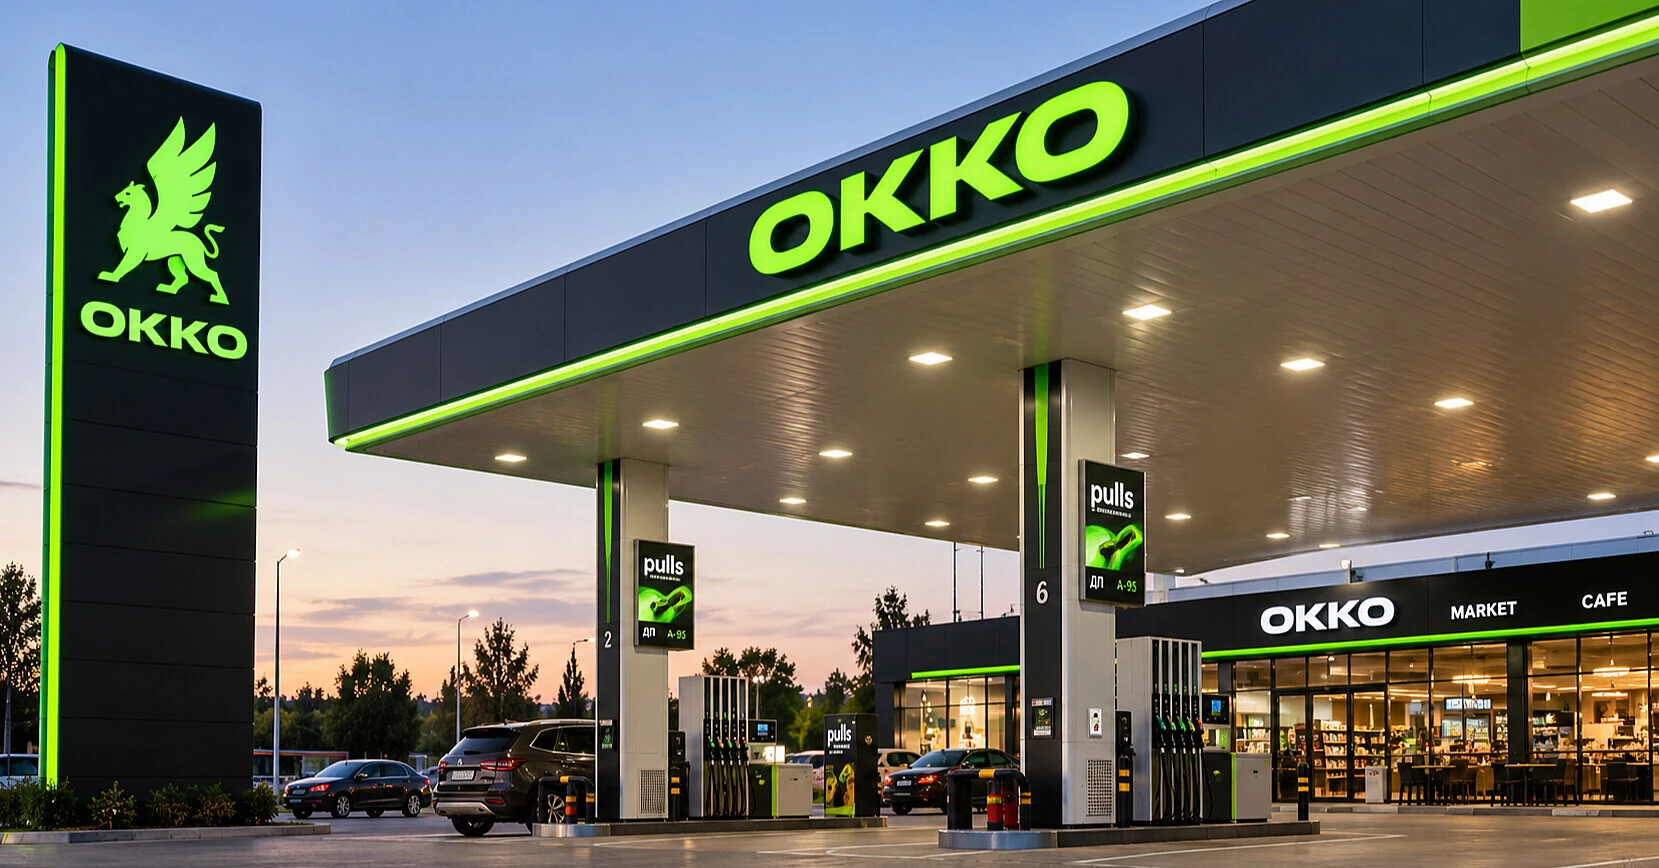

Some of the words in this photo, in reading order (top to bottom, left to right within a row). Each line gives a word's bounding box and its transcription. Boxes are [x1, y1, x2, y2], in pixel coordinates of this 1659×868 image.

[748, 81, 1130, 275] OKKO
[80, 301, 248, 360] OKKO
[1091, 481, 1134, 509] pulls
[644, 554, 684, 576] pulls
[1036, 581, 1049, 604] 6
[1582, 592, 1628, 609] CAFE
[1260, 597, 1395, 634] OKKO
[1451, 601, 1518, 620] MARKET
[604, 631, 612, 648] 2
[828, 723, 852, 748] pulls
